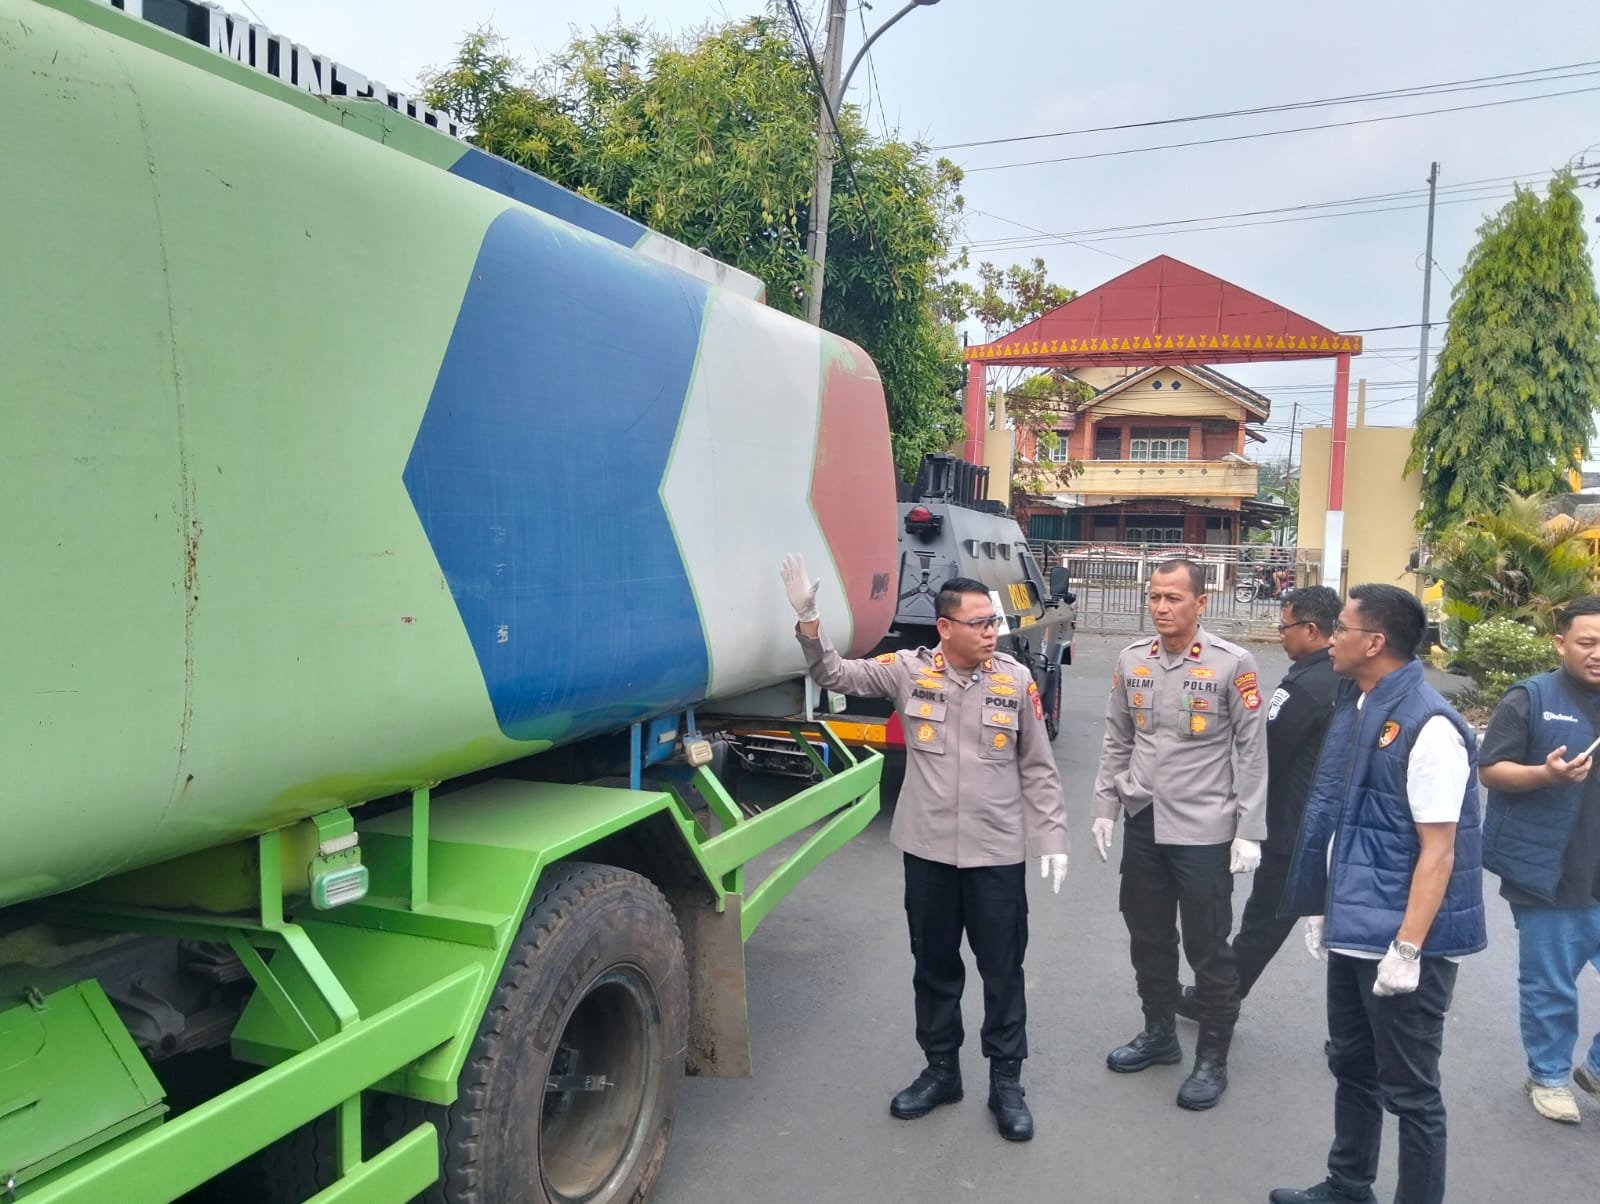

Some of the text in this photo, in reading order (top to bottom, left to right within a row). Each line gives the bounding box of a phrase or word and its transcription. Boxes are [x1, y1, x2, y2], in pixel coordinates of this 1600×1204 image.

[1126, 678, 1154, 689] HELMI
[1183, 680, 1217, 693] POLRI
[911, 688, 936, 702] ADIK
[985, 696, 1018, 710] POLRI
